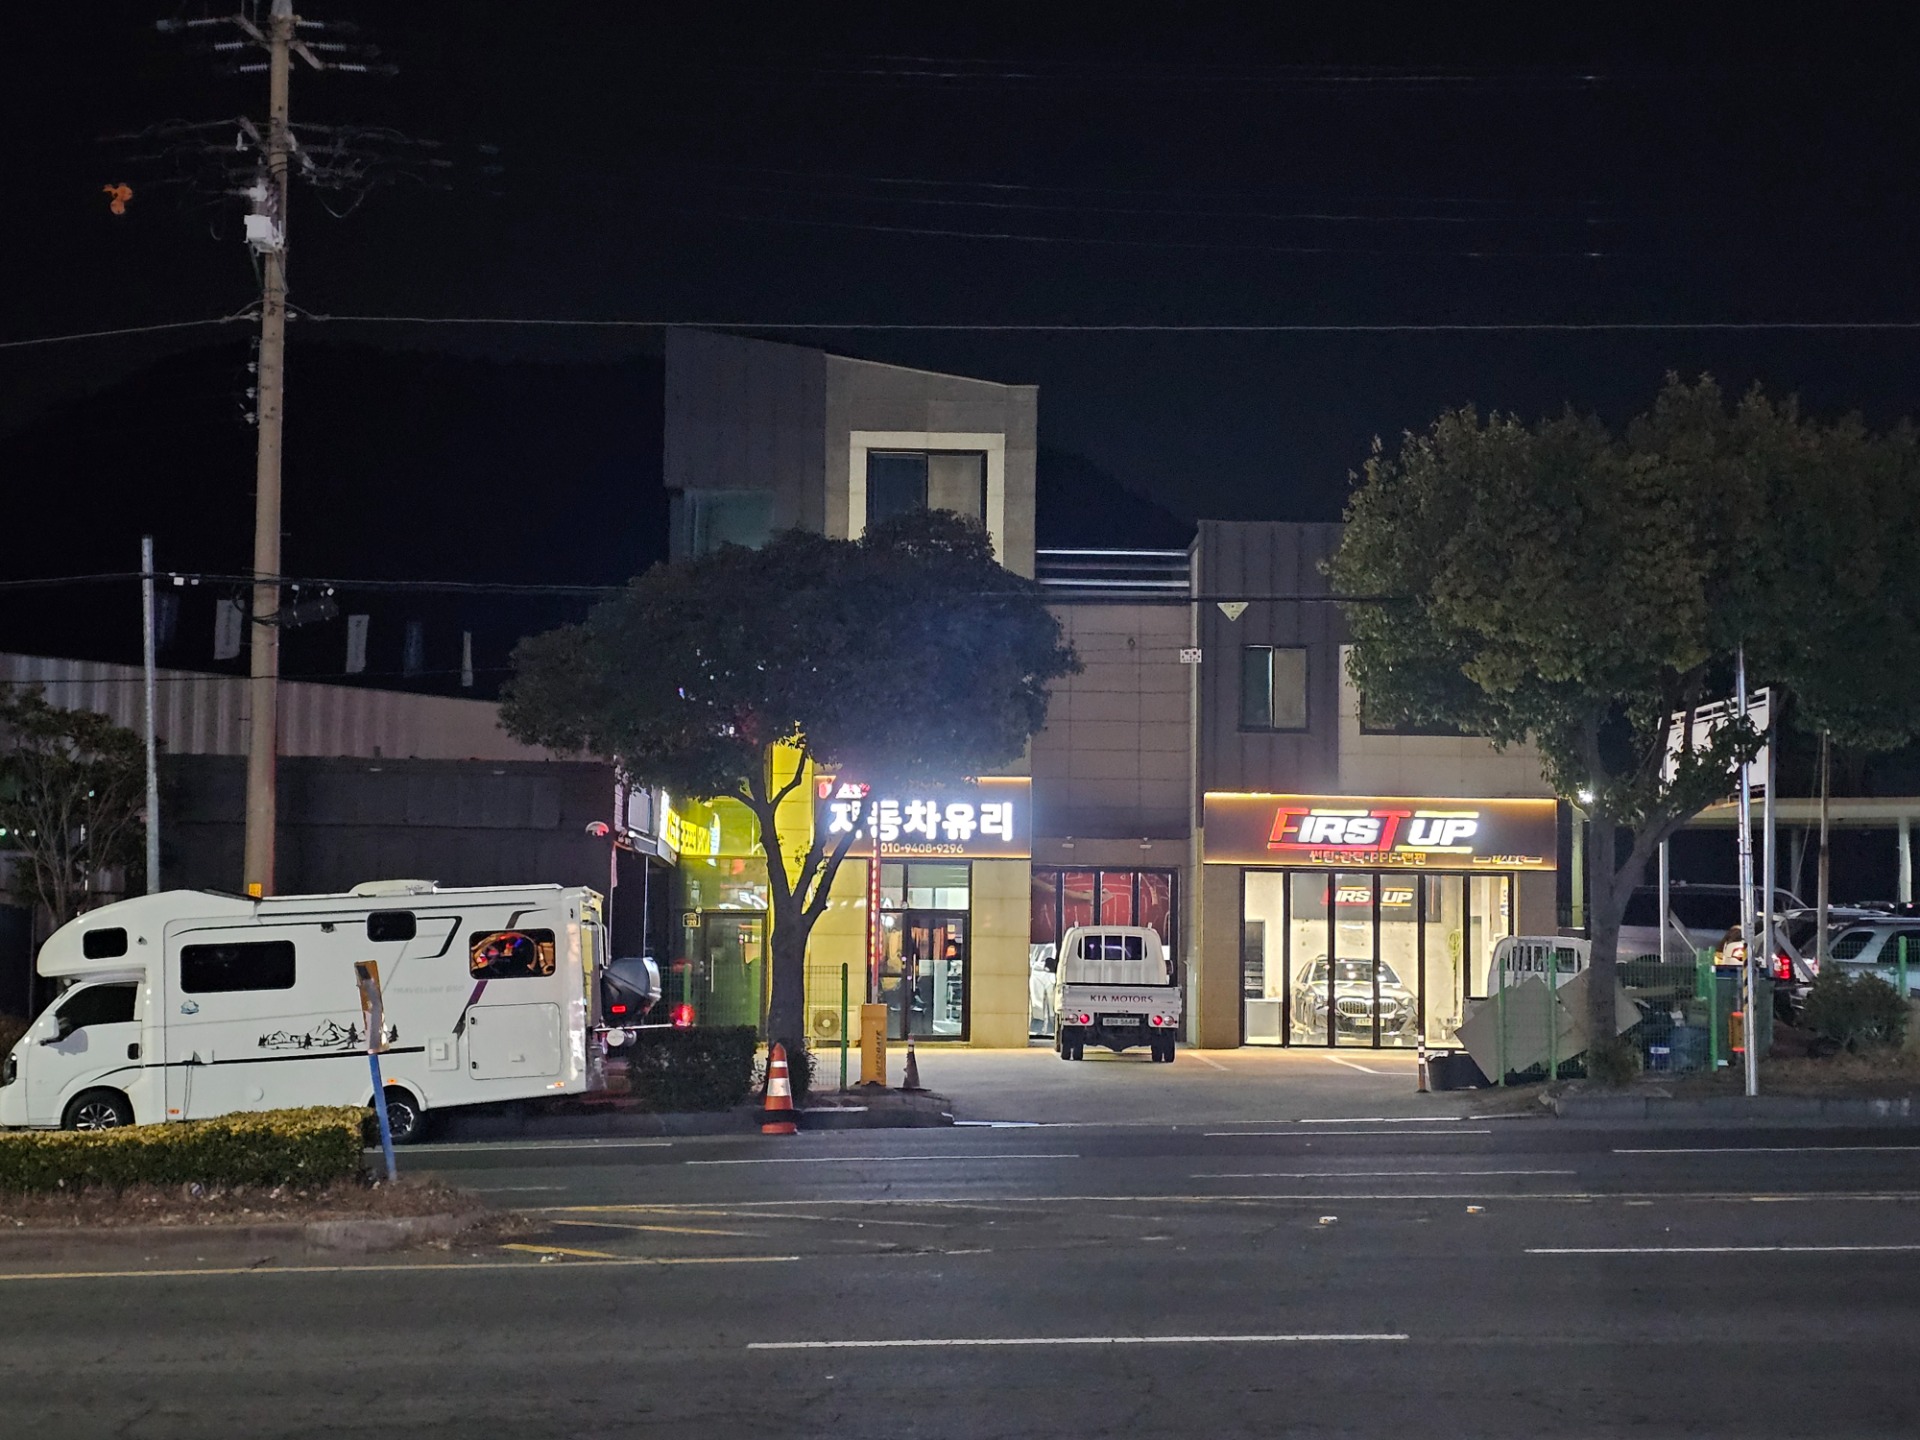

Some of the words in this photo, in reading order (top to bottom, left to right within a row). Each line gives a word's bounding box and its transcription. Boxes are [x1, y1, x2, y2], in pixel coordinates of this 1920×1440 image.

[828, 799, 1013, 841] 자동차유리
[1268, 808, 1411, 851] FIRST
[1407, 816, 1479, 848] UP
[1381, 891, 1413, 904] UP
[1111, 995, 1153, 1003] MOTORS
